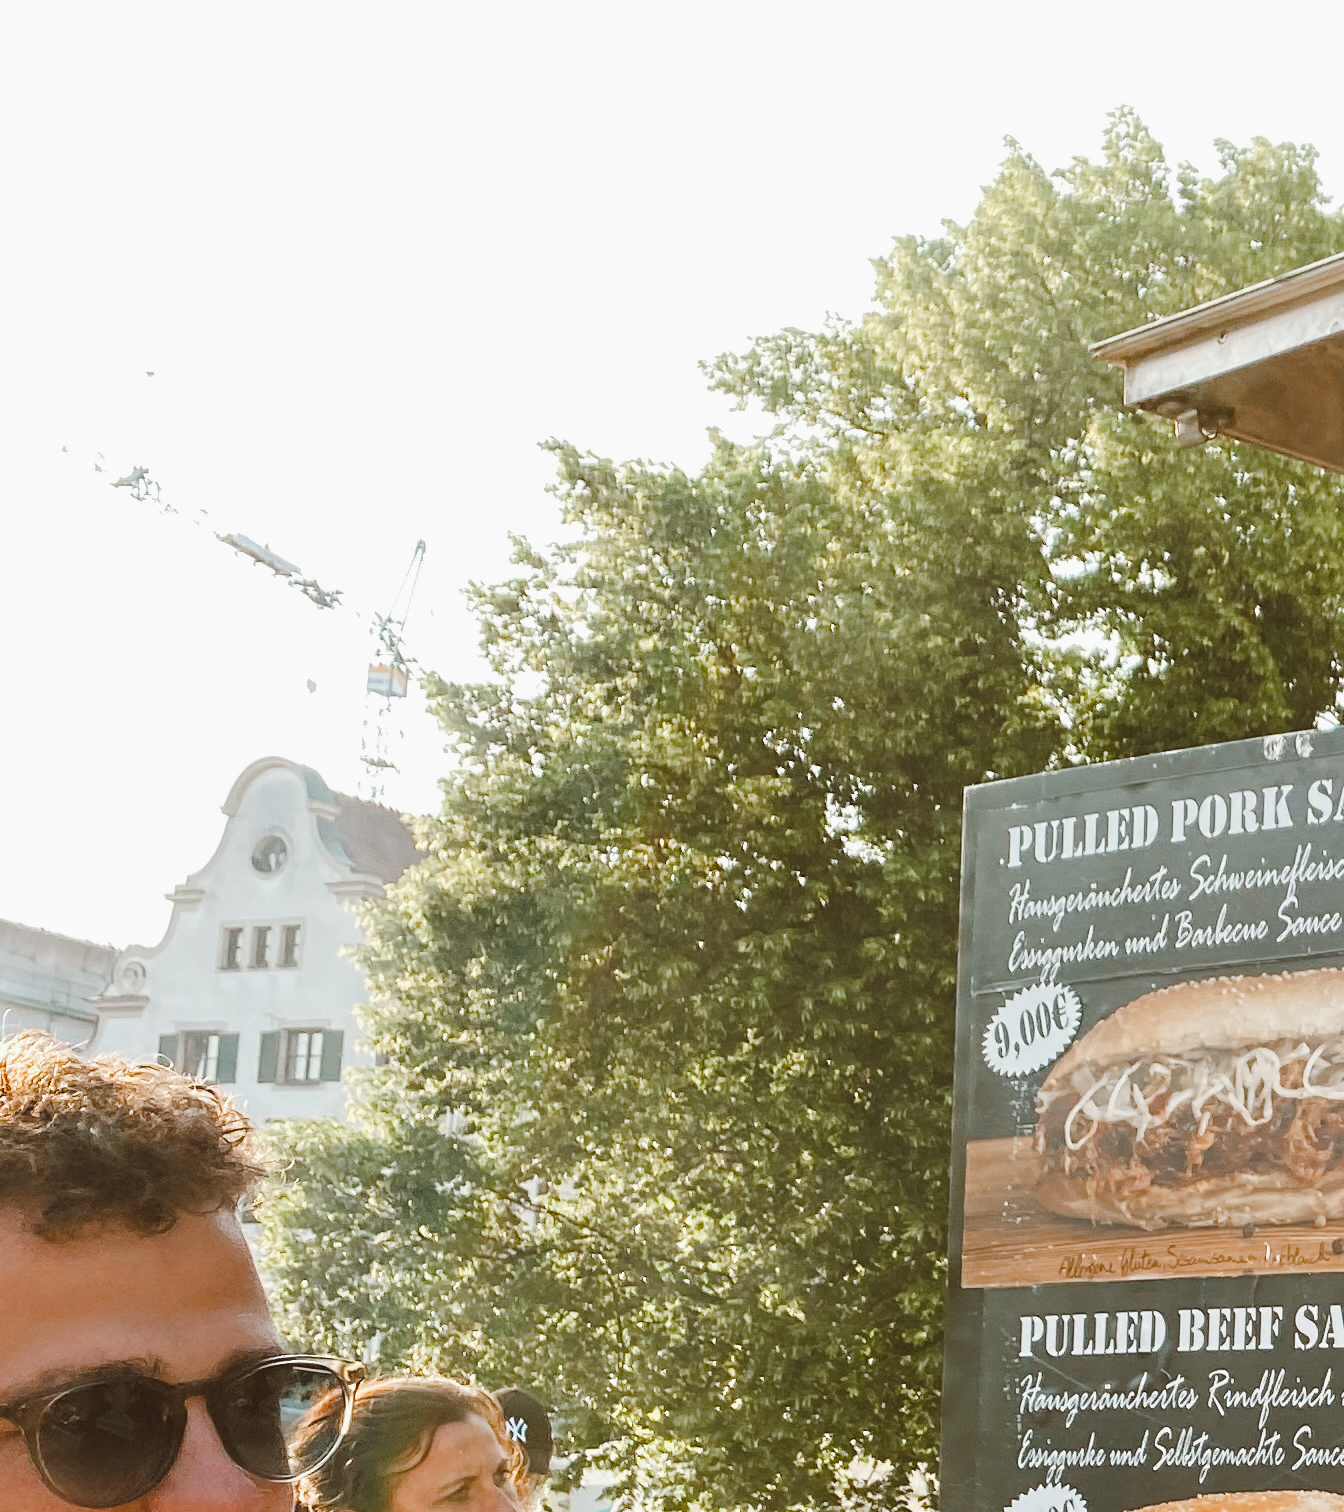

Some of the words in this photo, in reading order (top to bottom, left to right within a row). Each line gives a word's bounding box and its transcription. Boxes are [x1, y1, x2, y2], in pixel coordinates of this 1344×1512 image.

[1007, 804, 1160, 868] PULLED
[1170, 784, 1294, 843] PORK
[1008, 865, 1182, 932] Hausgeräuchertes
[1008, 925, 1120, 983] Essiggurken
[1125, 912, 1170, 954] und
[1175, 903, 1269, 949] Barbecue
[1276, 897, 1343, 943] Sauce
[993, 991, 1070, 1060] 9,00€
[1019, 1309, 1167, 1357] PULLED
[1177, 1306, 1284, 1352] BEEF
[505, 1415, 528, 1444] NY
[1019, 1371, 1200, 1429] Hausgeräuchertes
[1207, 1367, 1336, 1430] Rindfleisch
[1017, 1429, 1106, 1484] Essiggurke
[1110, 1429, 1150, 1468] und
[1153, 1425, 1286, 1484] Selbstgemachte
